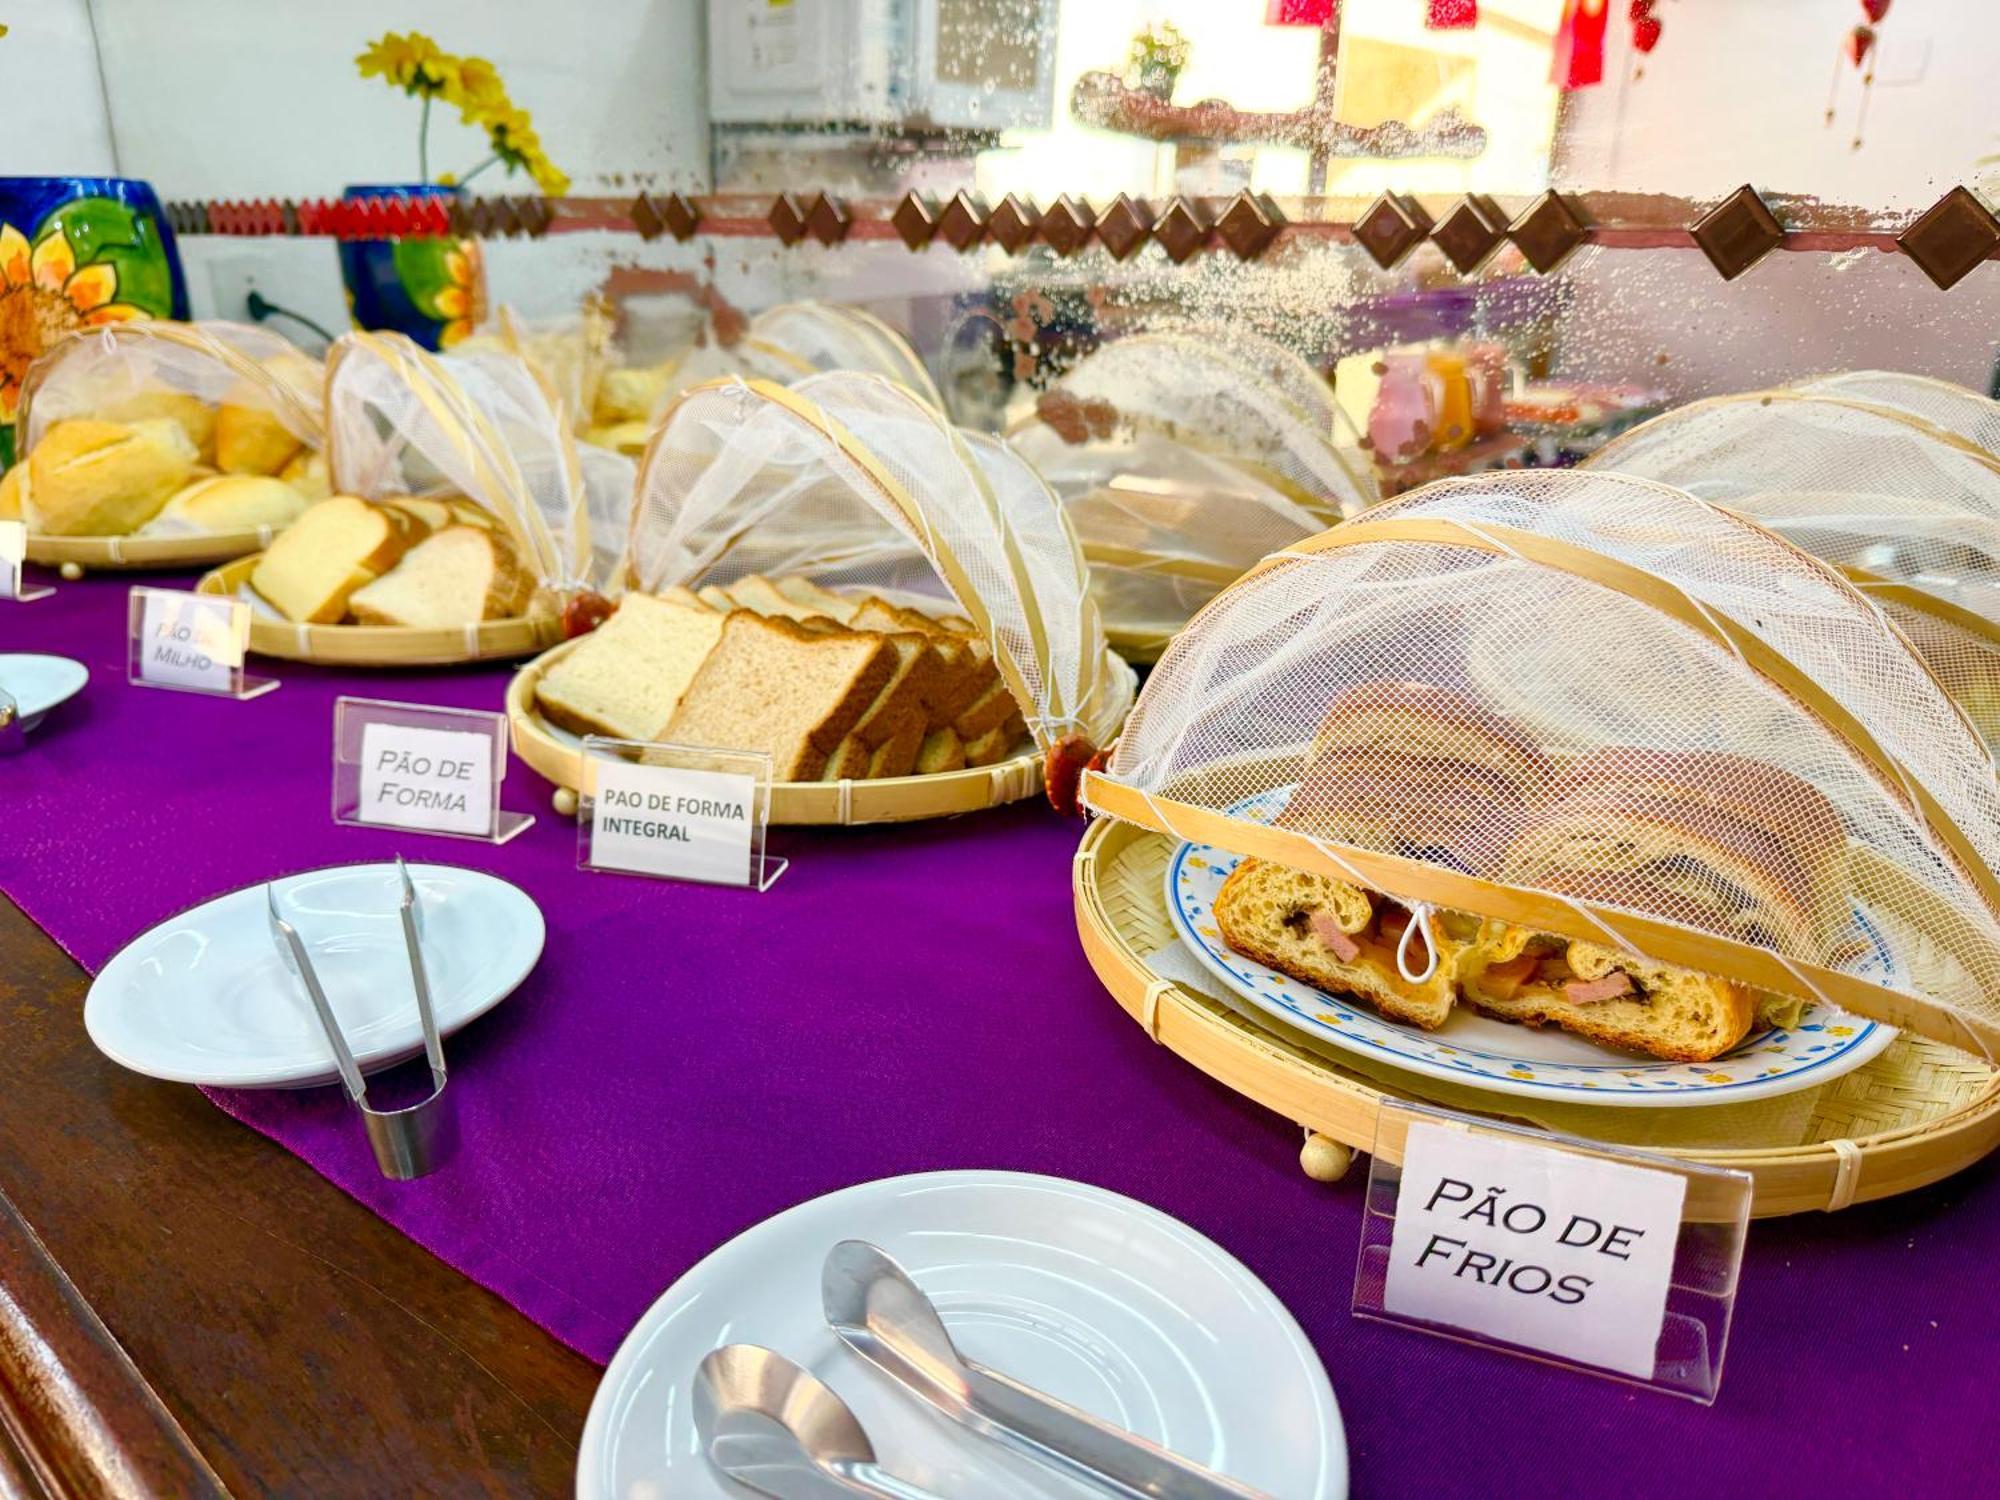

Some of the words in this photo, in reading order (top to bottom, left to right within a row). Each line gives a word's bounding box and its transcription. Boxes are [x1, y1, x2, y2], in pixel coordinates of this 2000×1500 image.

[154, 645, 212, 671] MILHO
[377, 750, 431, 775] PÃO
[438, 761, 475, 780] DE
[378, 782, 466, 811] FORMA
[604, 789, 643, 808] PAO
[648, 794, 671, 811] DE
[676, 797, 745, 820] FORMA
[603, 817, 691, 842] INTEGRAL
[1423, 1177, 1547, 1234] PÃO
[1556, 1215, 1645, 1261] DE
[1414, 1234, 1594, 1304] FRIOS
